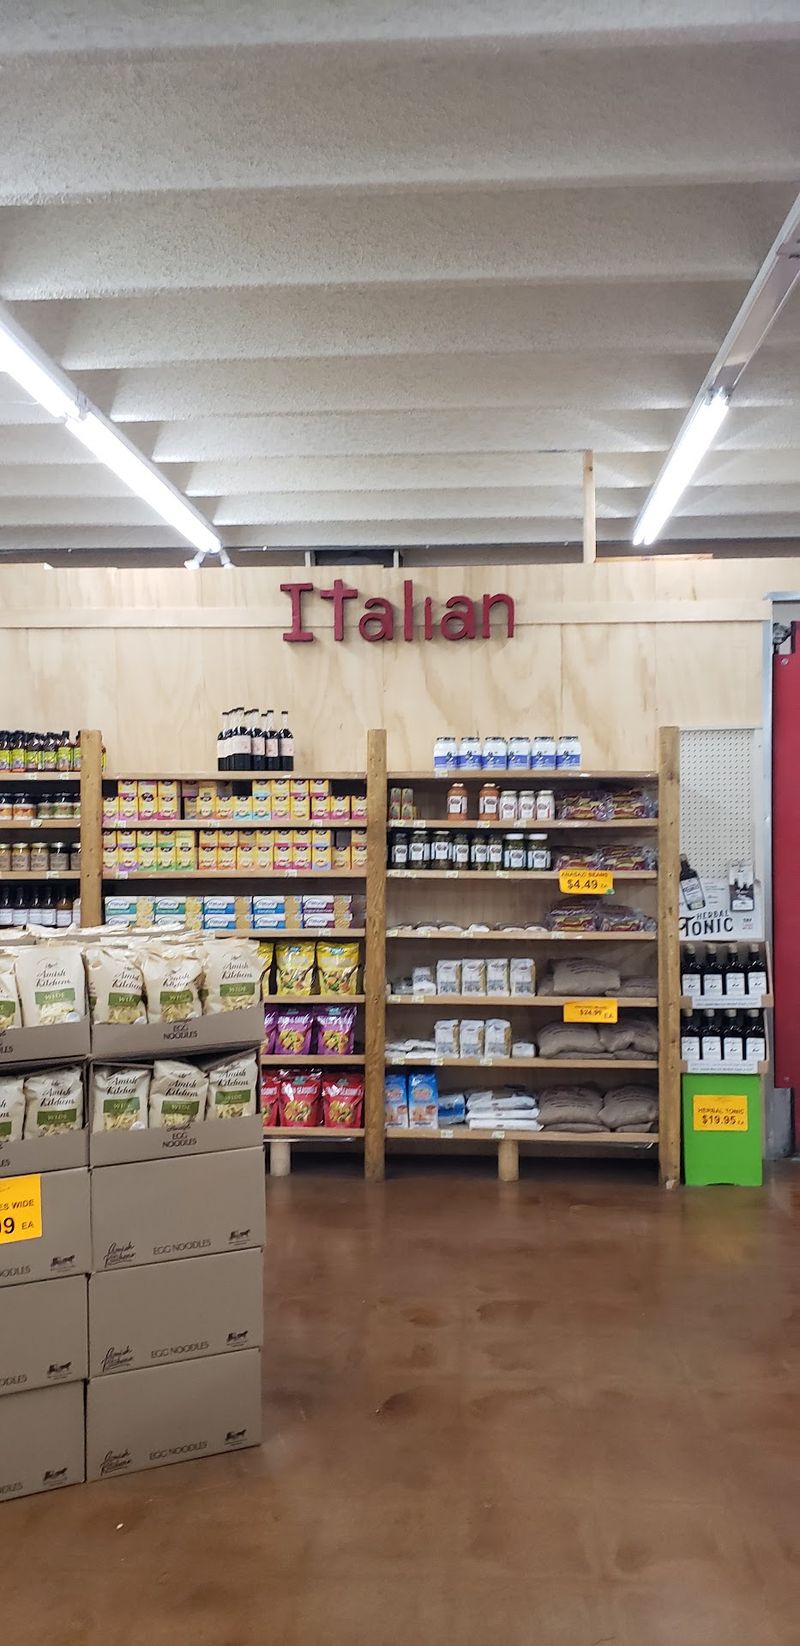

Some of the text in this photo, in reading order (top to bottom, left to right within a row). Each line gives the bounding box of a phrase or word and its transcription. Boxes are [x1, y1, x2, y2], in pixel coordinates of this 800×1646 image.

[280, 579, 515, 642] Italian
[567, 879, 598, 889] $4.49
[696, 909, 729, 920] HERBAL
[679, 917, 733, 937] TONIC
[163, 1030, 198, 1040] NOODLES
[702, 1115, 736, 1125] $19.95
[162, 1137, 197, 1148] NOODLES
[12, 1199, 34, 1209] WIDE
[0, 1216, 34, 1234] 9 EA
[172, 1238, 212, 1252] NOODLES
[170, 1340, 210, 1354] NOODLES
[168, 1440, 208, 1455] NOODLES
